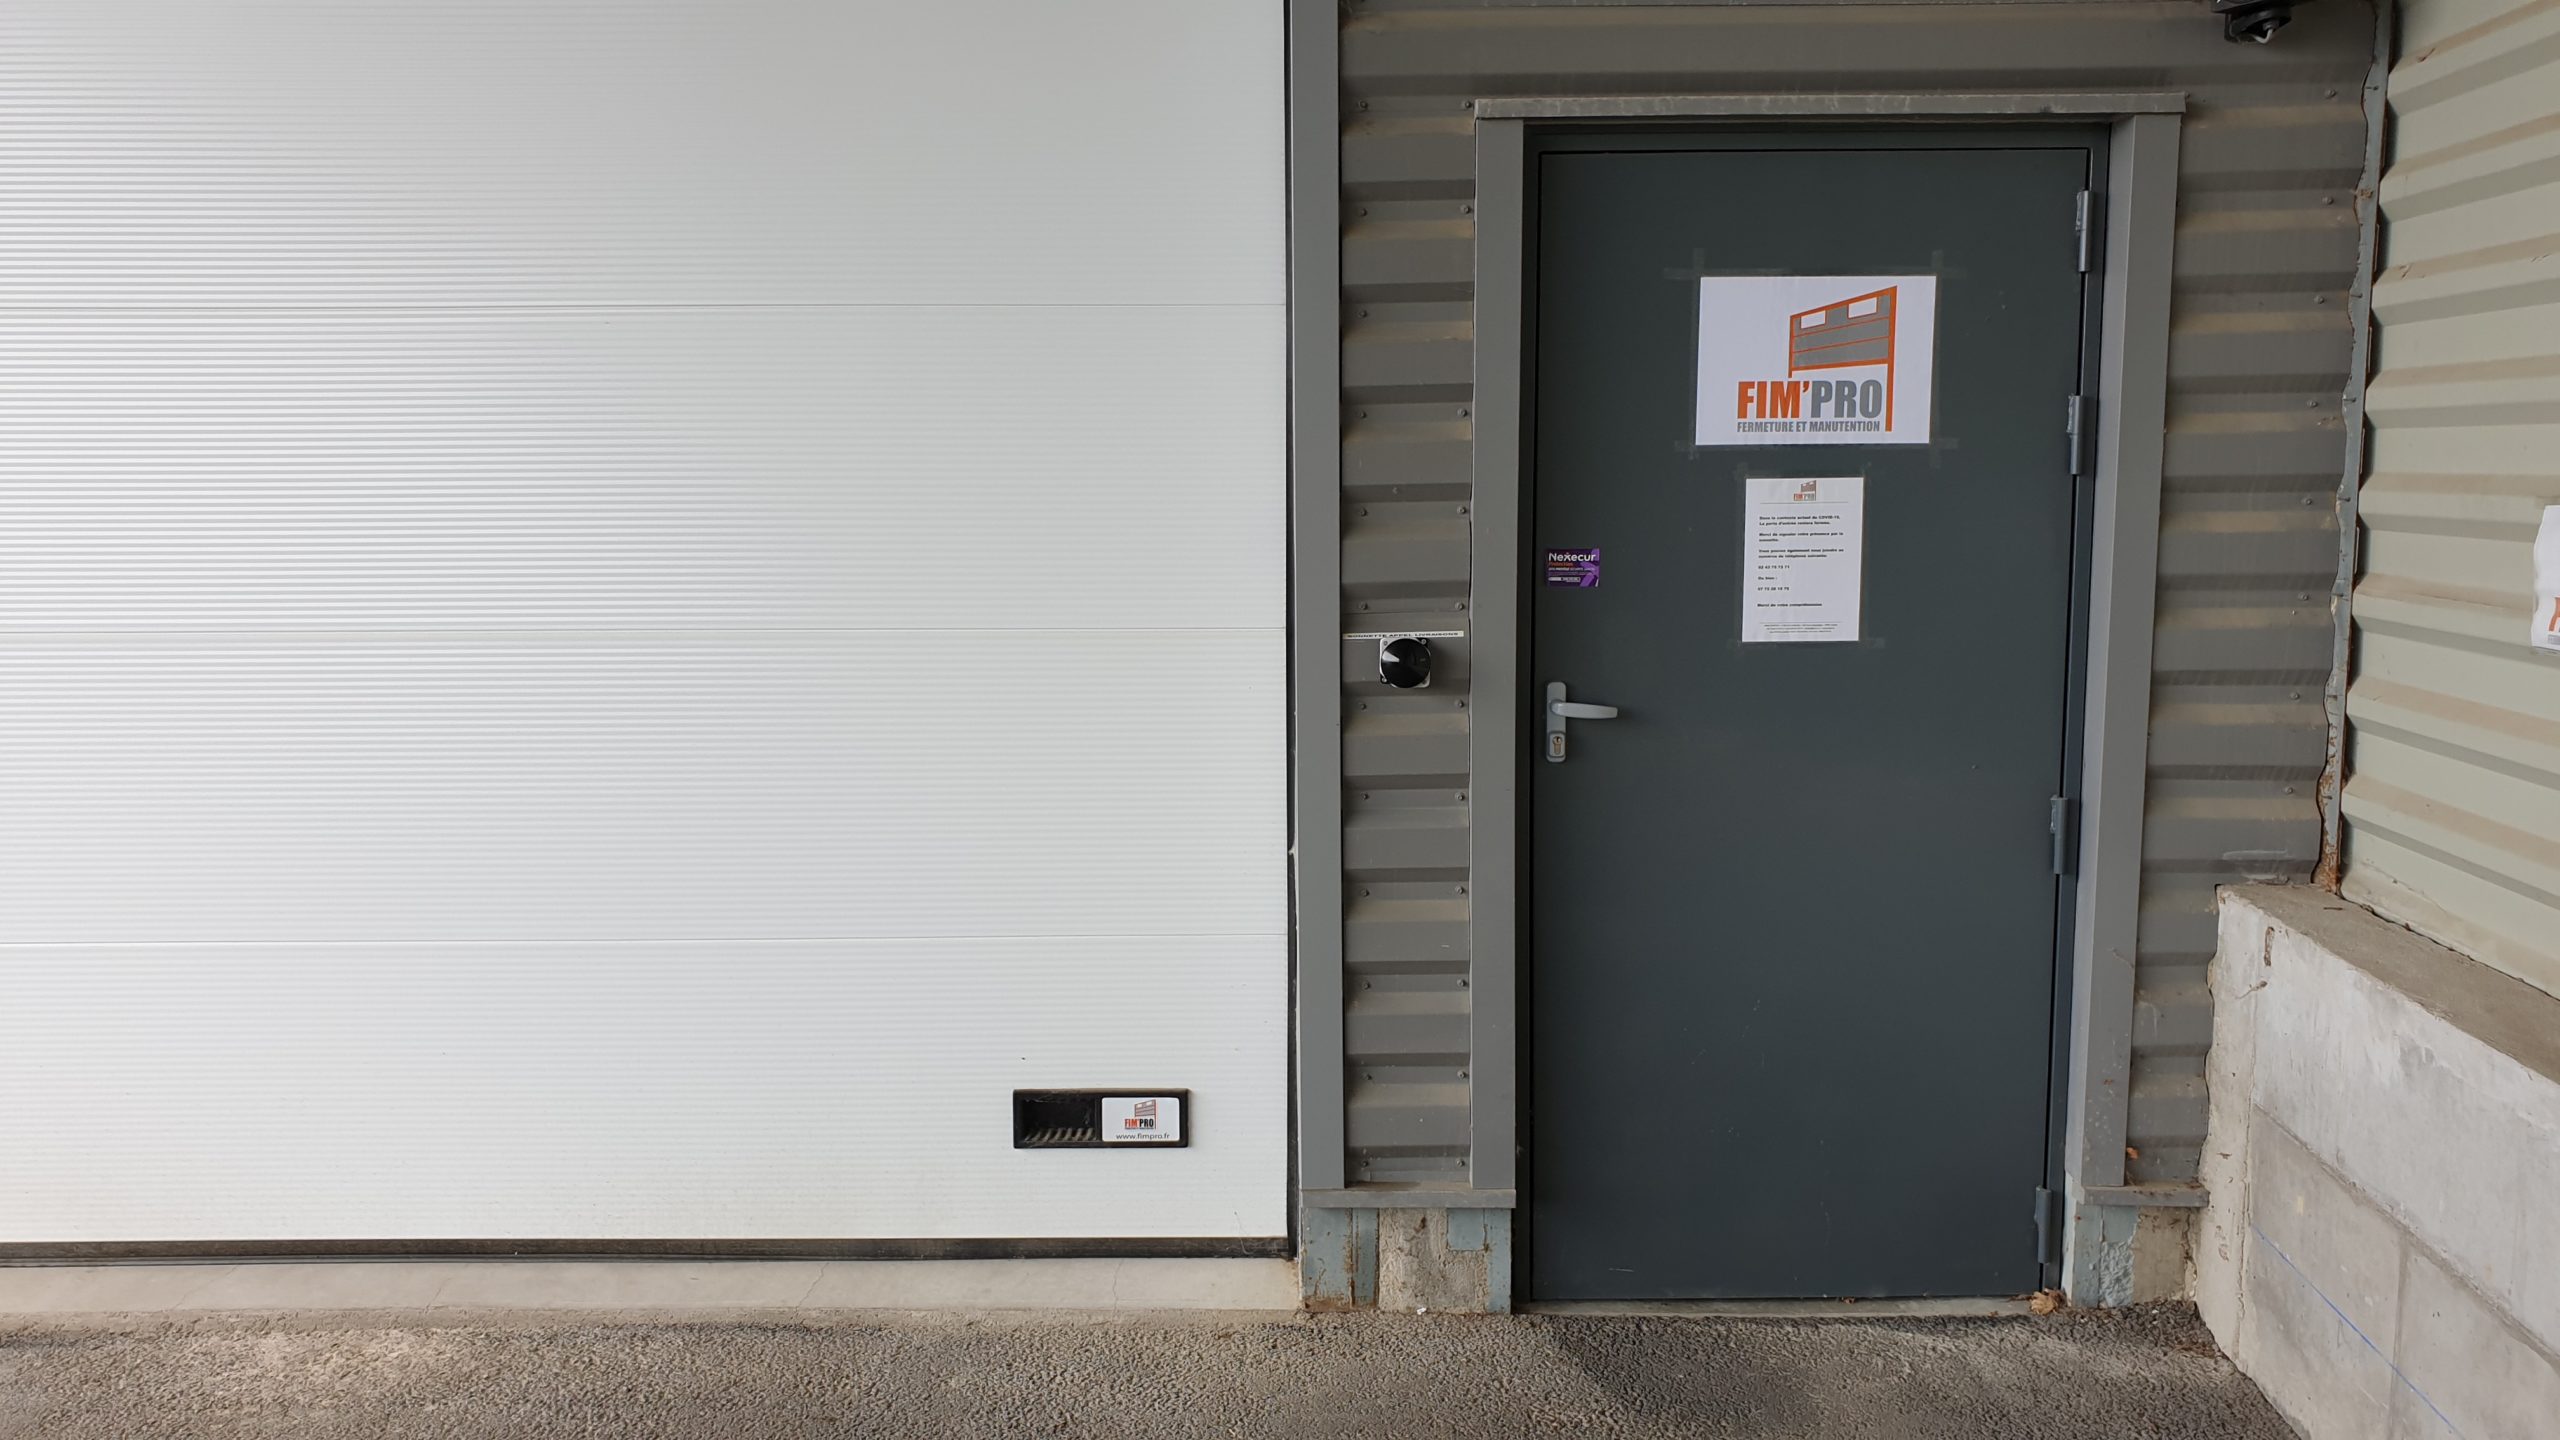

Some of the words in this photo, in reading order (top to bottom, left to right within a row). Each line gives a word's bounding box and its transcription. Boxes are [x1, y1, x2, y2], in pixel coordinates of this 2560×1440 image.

[1736, 379, 1883, 419] FIM'PRO
[1736, 421, 1794, 433] FERMETURE
[1795, 420, 1807, 433] ET
[1808, 420, 1880, 432] MANUTENTION
[1548, 552, 1596, 562] Nexecur
[1116, 1132, 1170, 1141] www.fimpro.fr
